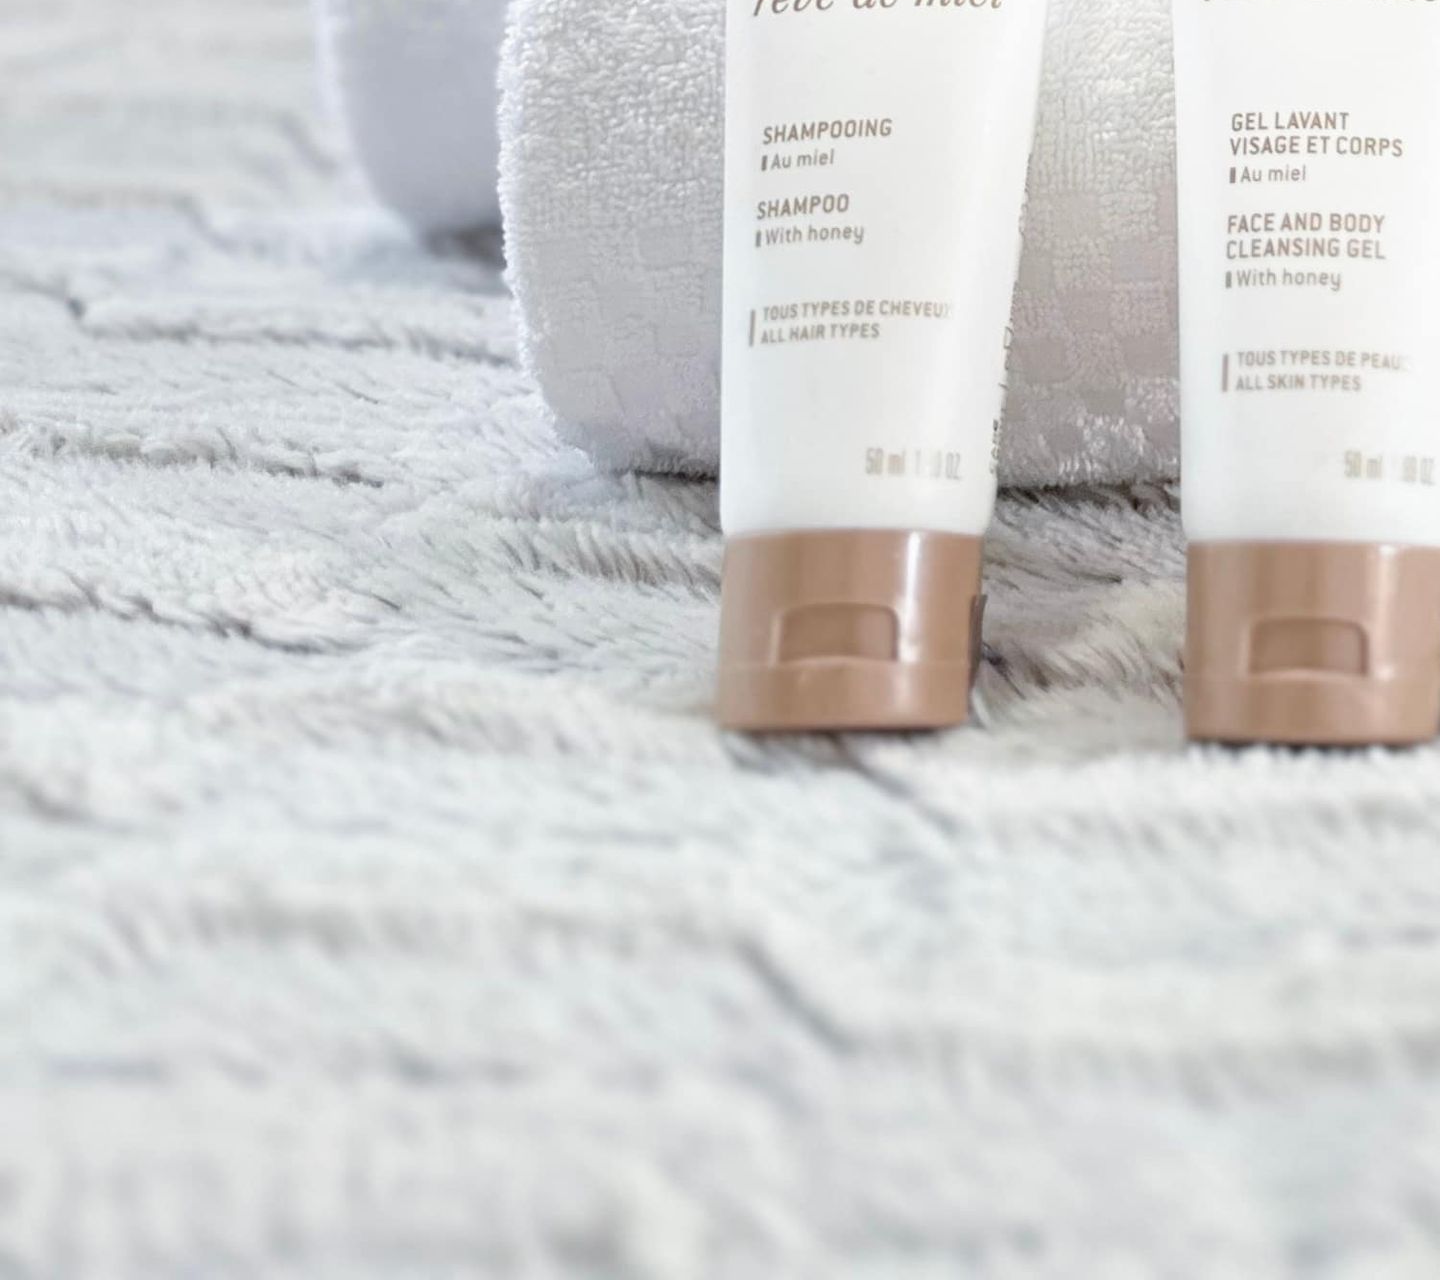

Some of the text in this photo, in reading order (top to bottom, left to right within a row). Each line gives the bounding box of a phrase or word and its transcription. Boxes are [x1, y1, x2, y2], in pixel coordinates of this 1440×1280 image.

[762, 118, 893, 146] SHAMPOOING
[1231, 111, 1350, 133] GEL LAVANT
[1230, 136, 1404, 158] VISAGE ET CORPS
[770, 148, 835, 170] Au miel
[1240, 165, 1307, 183] Au miel
[757, 193, 850, 220] SHAMPOO
[764, 223, 865, 245] With honey
[1227, 212, 1385, 234] FACE AND BODY
[1226, 238, 1387, 260] CLEANSING GEL
[1236, 269, 1342, 291] With honey
[763, 302, 798, 321] TOUS
[802, 301, 850, 319] TYPES
[854, 300, 874, 316] DE
[760, 322, 880, 345] ALL HAIR TYPES
[1237, 350, 1411, 371] TOUS TYPES DE PEAU
[1236, 374, 1362, 392] ALL SKIN TYPES
